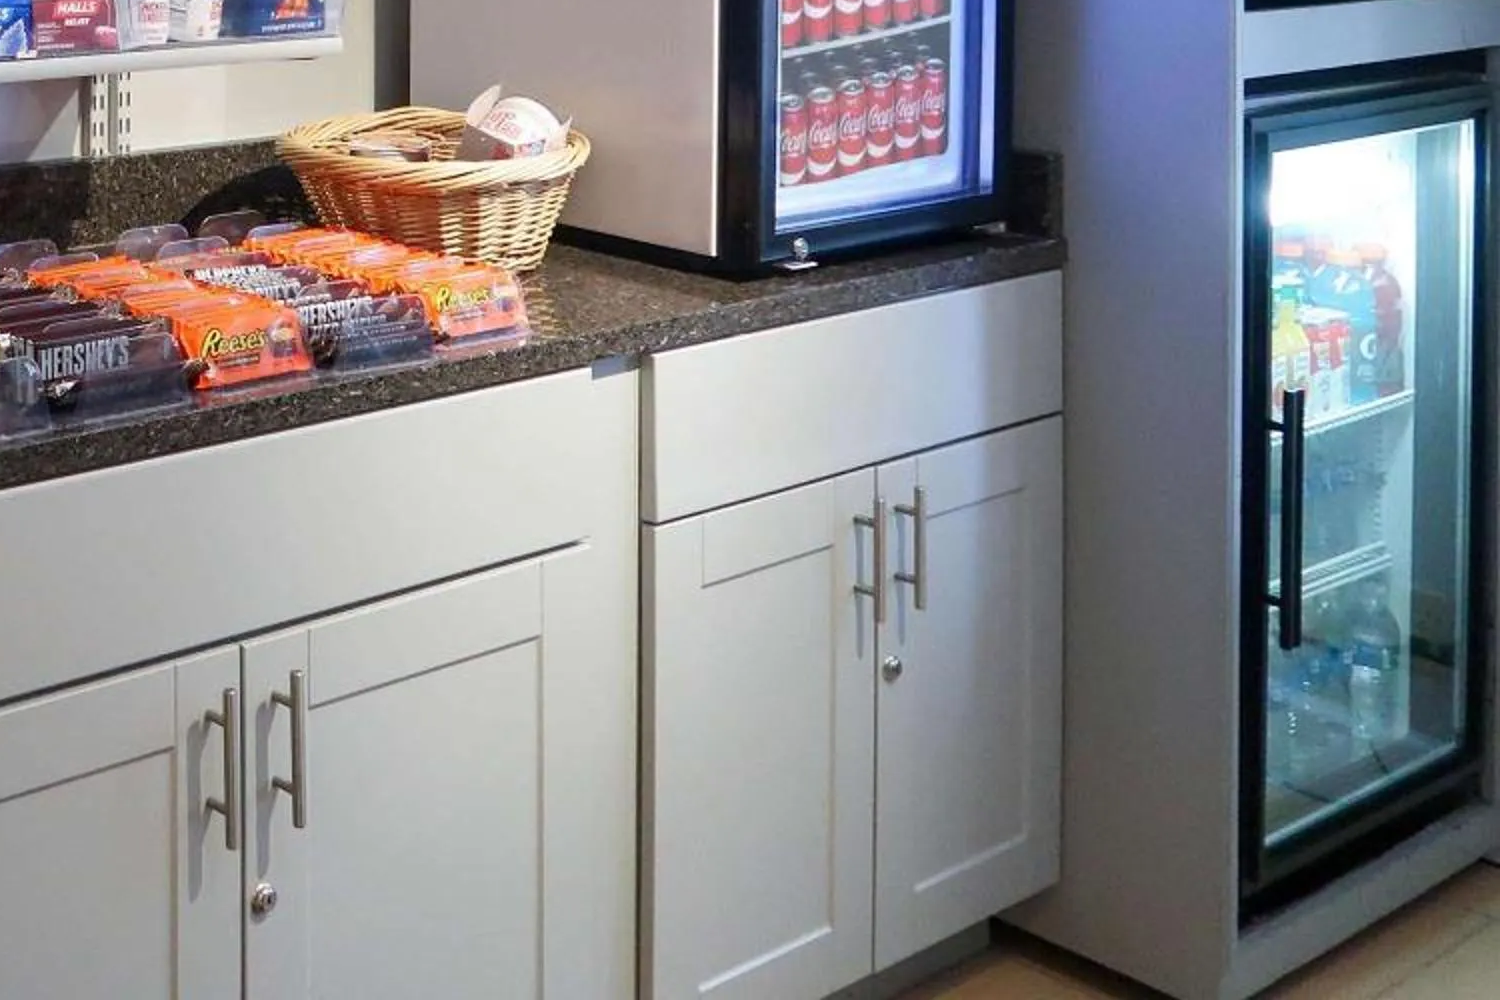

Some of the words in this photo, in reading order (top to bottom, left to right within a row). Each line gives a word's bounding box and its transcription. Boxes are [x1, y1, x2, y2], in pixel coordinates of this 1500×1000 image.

[56, 1, 98, 14] HALLS
[436, 285, 491, 311] Reese's
[202, 327, 267, 357] Reese's
[41, 336, 129, 381] HERSHEY'S
